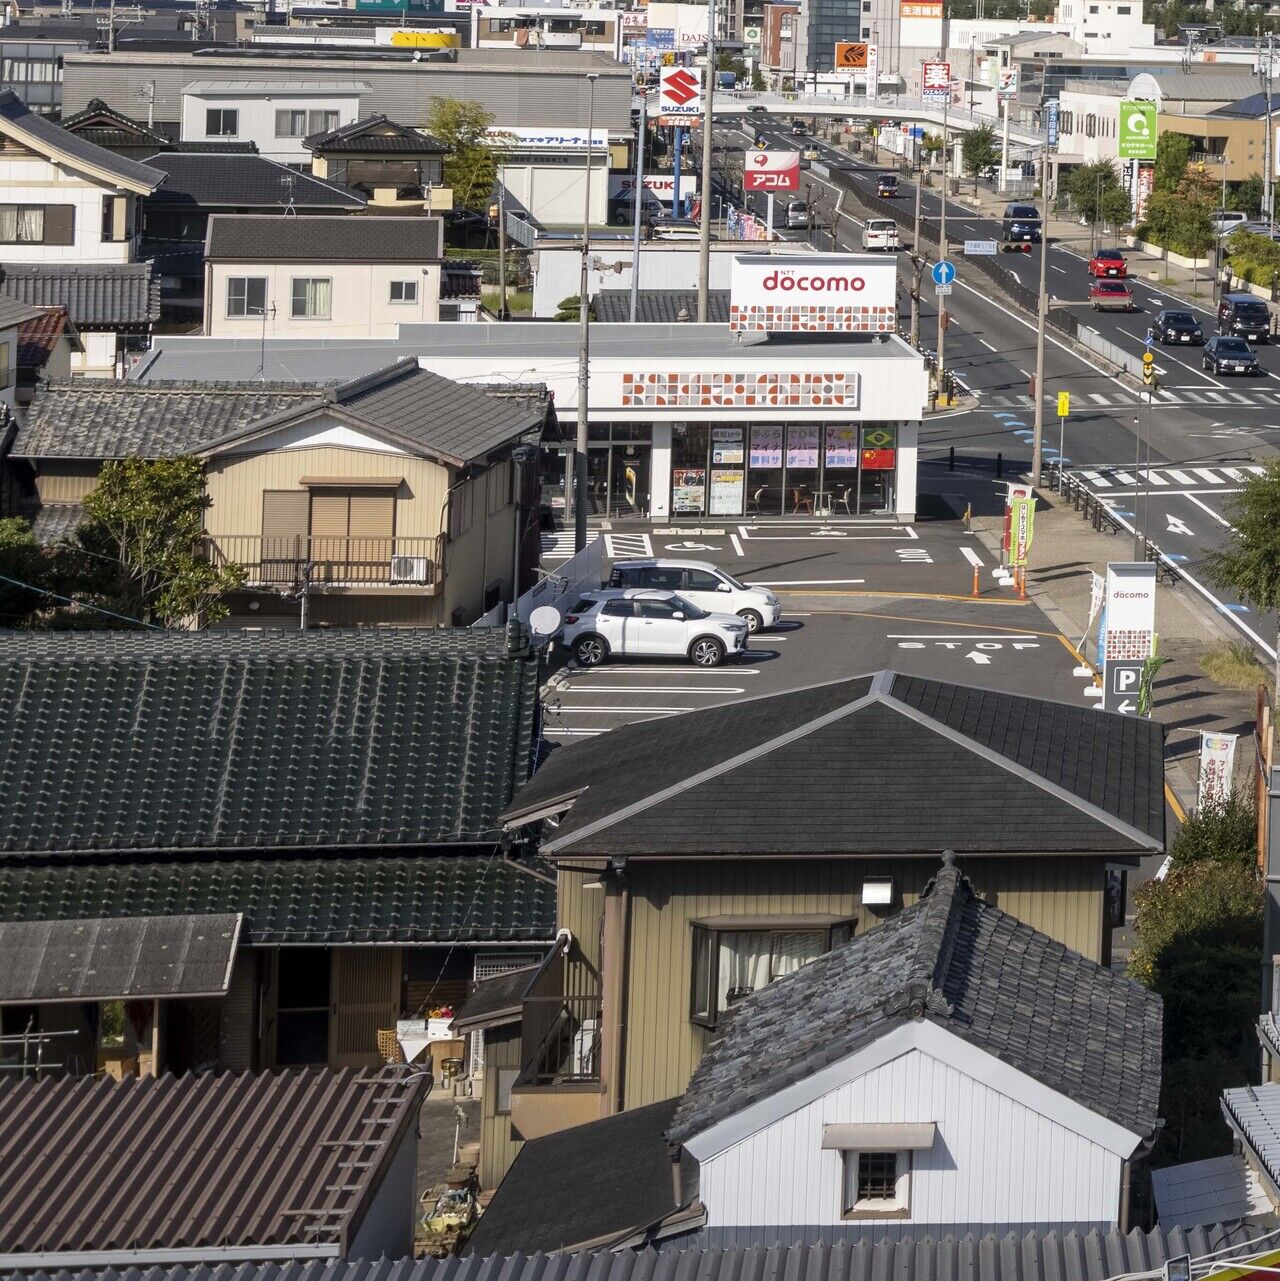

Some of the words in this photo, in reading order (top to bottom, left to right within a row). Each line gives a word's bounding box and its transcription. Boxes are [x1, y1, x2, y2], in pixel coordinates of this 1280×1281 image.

[925, 63, 949, 89] 薬
[620, 180, 675, 191] SZUK
[752, 174, 791, 186] アコム
[762, 270, 866, 292] docomo
[1113, 589, 1149, 600] docomo
[897, 641, 1041, 651] STOP
[1119, 670, 1136, 691] P
